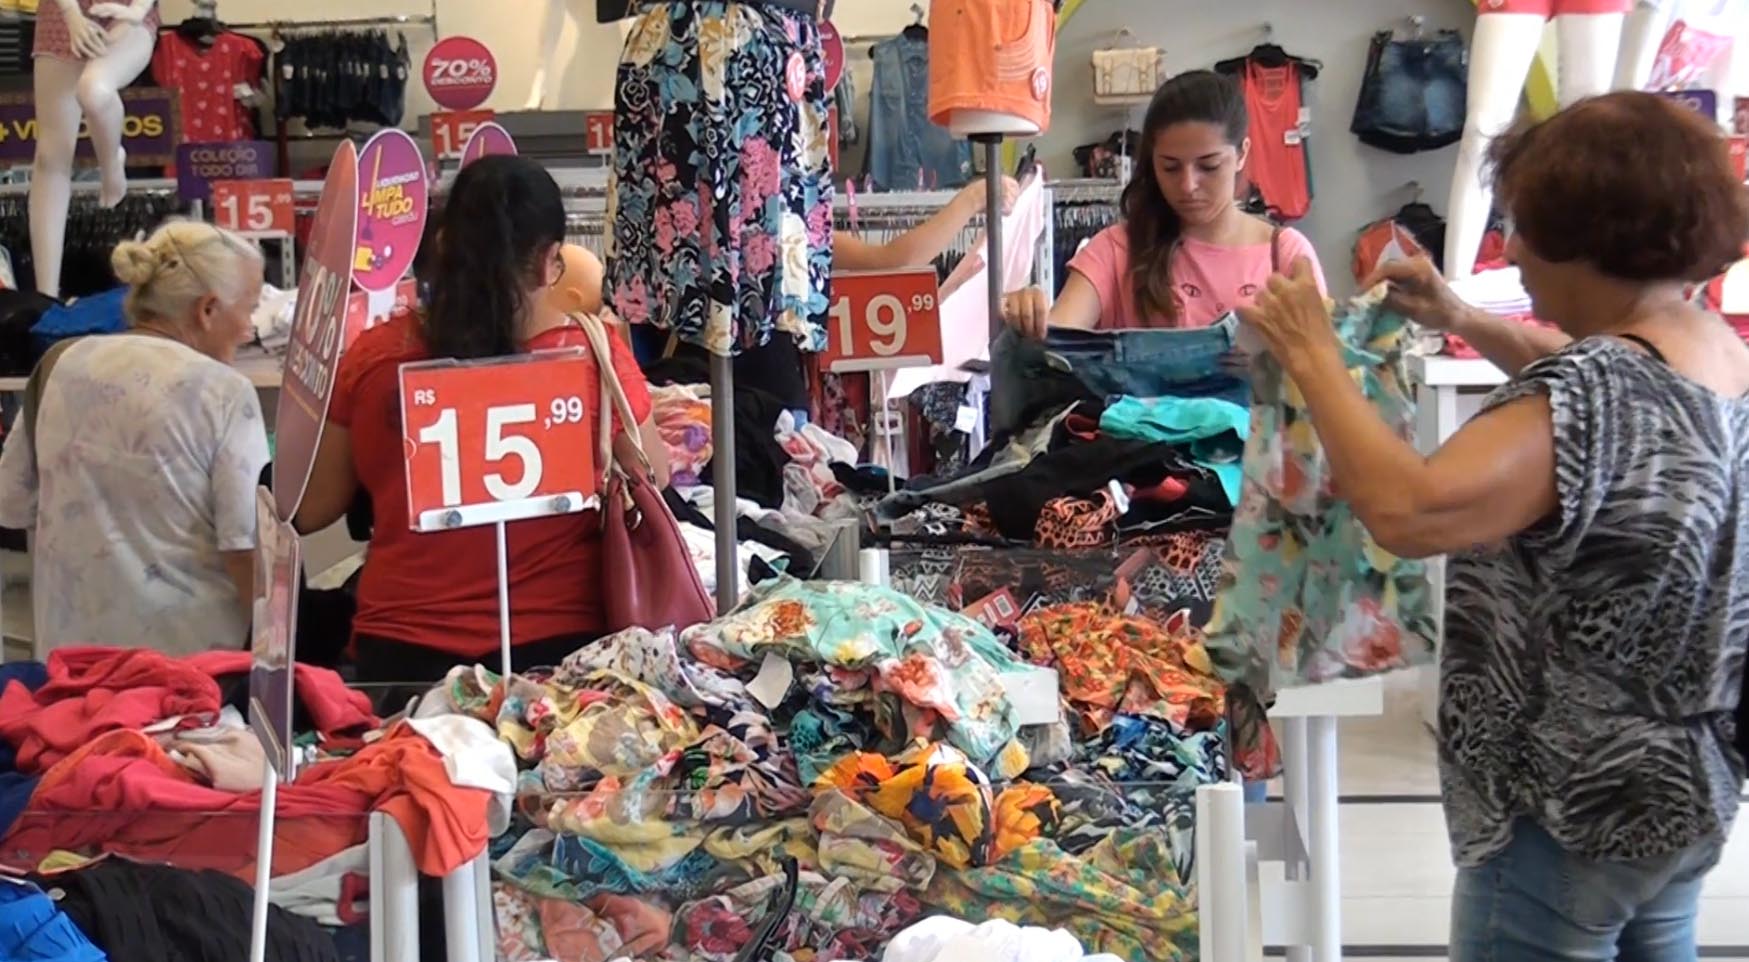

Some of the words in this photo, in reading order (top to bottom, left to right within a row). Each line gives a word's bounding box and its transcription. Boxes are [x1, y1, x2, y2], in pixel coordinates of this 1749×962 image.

[431, 58, 491, 78] 70%
[220, 194, 274, 230] 15
[376, 196, 414, 219] TUDO
[296, 256, 344, 360] 70%
[828, 294, 907, 356] 19
[413, 390, 436, 406] R$
[419, 403, 544, 507] 15
